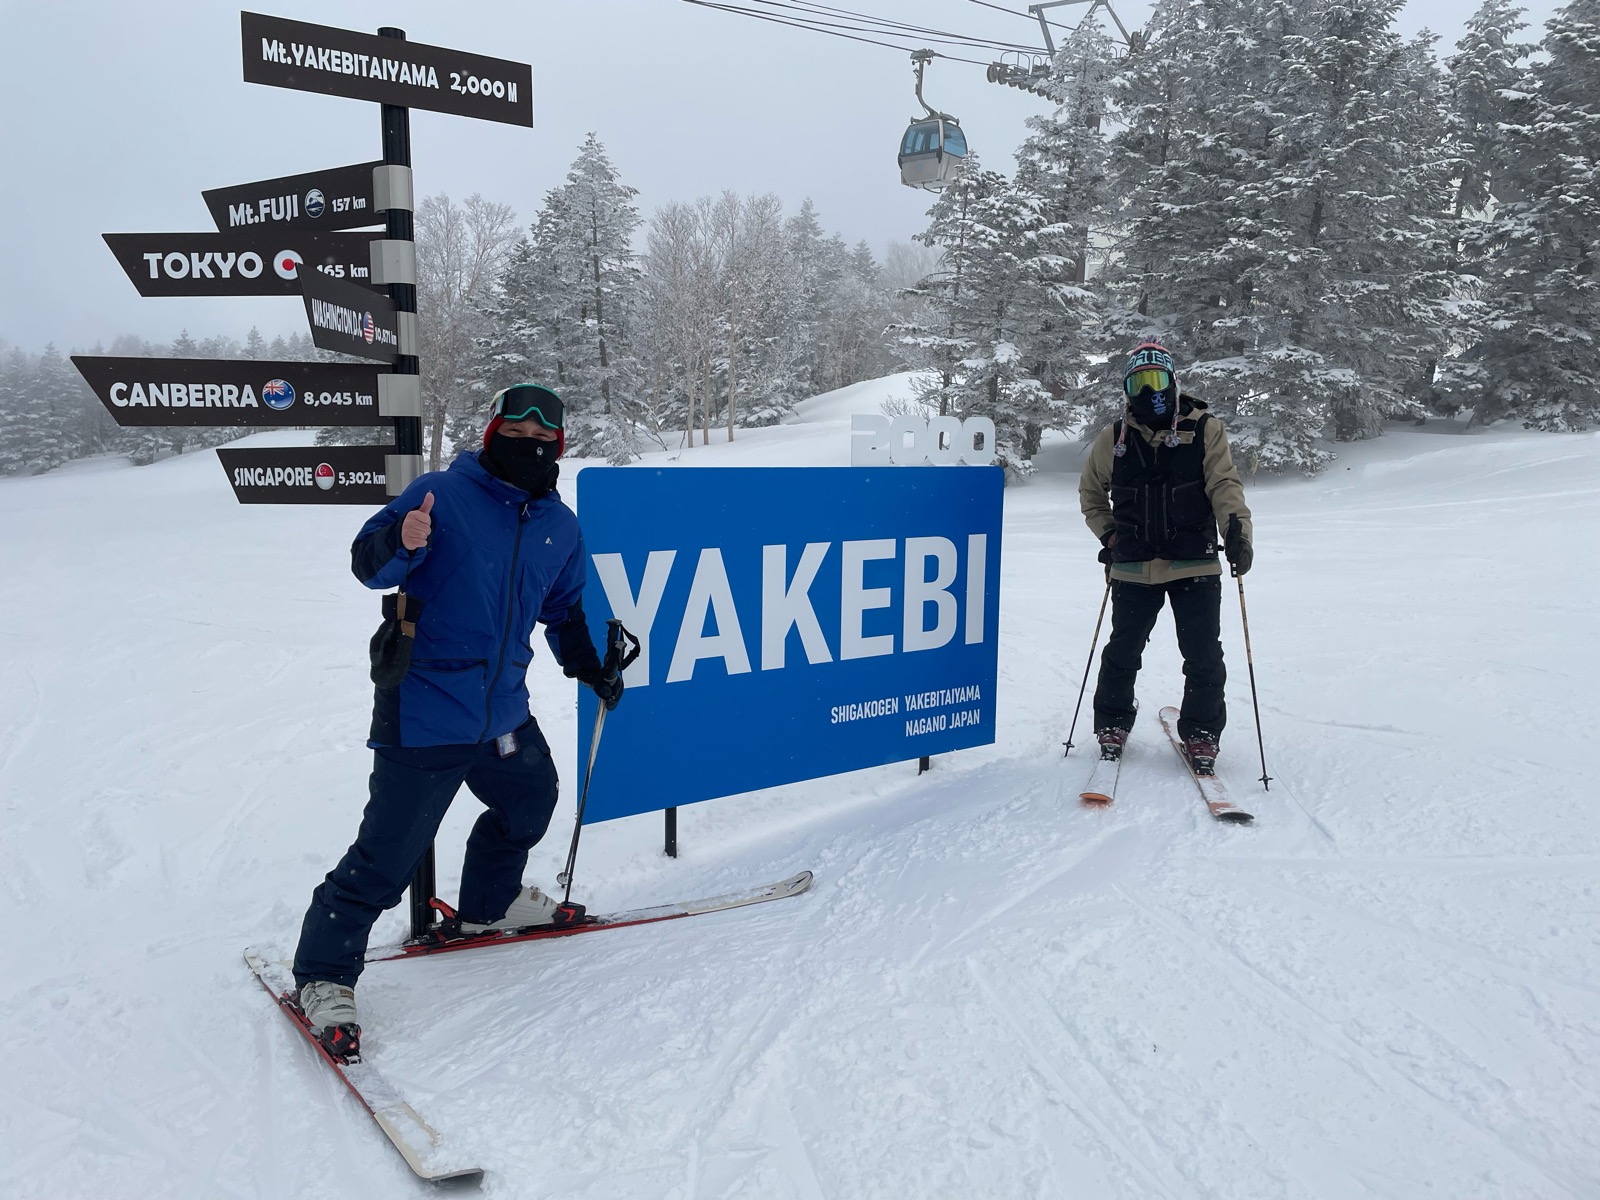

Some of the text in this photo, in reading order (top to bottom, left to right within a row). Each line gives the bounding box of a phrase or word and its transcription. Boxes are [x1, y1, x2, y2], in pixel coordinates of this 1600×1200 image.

[261, 37, 440, 89] Mt.YAKEBITAIYAMA
[228, 194, 366, 227] Mt.FUJI 157 km
[143, 251, 264, 279] TOKYO
[350, 263, 369, 278] km
[109, 382, 373, 408] CANBERRA 8,045 km
[851, 414, 996, 466] 2000
[234, 467, 386, 486] SINGAPORE 5,302 km
[591, 533, 987, 689] YAKEBI
[830, 684, 981, 725] SHIGAKOGEN YAKEBITAIYAMA
[905, 708, 981, 737] NAGANO JAPAN
